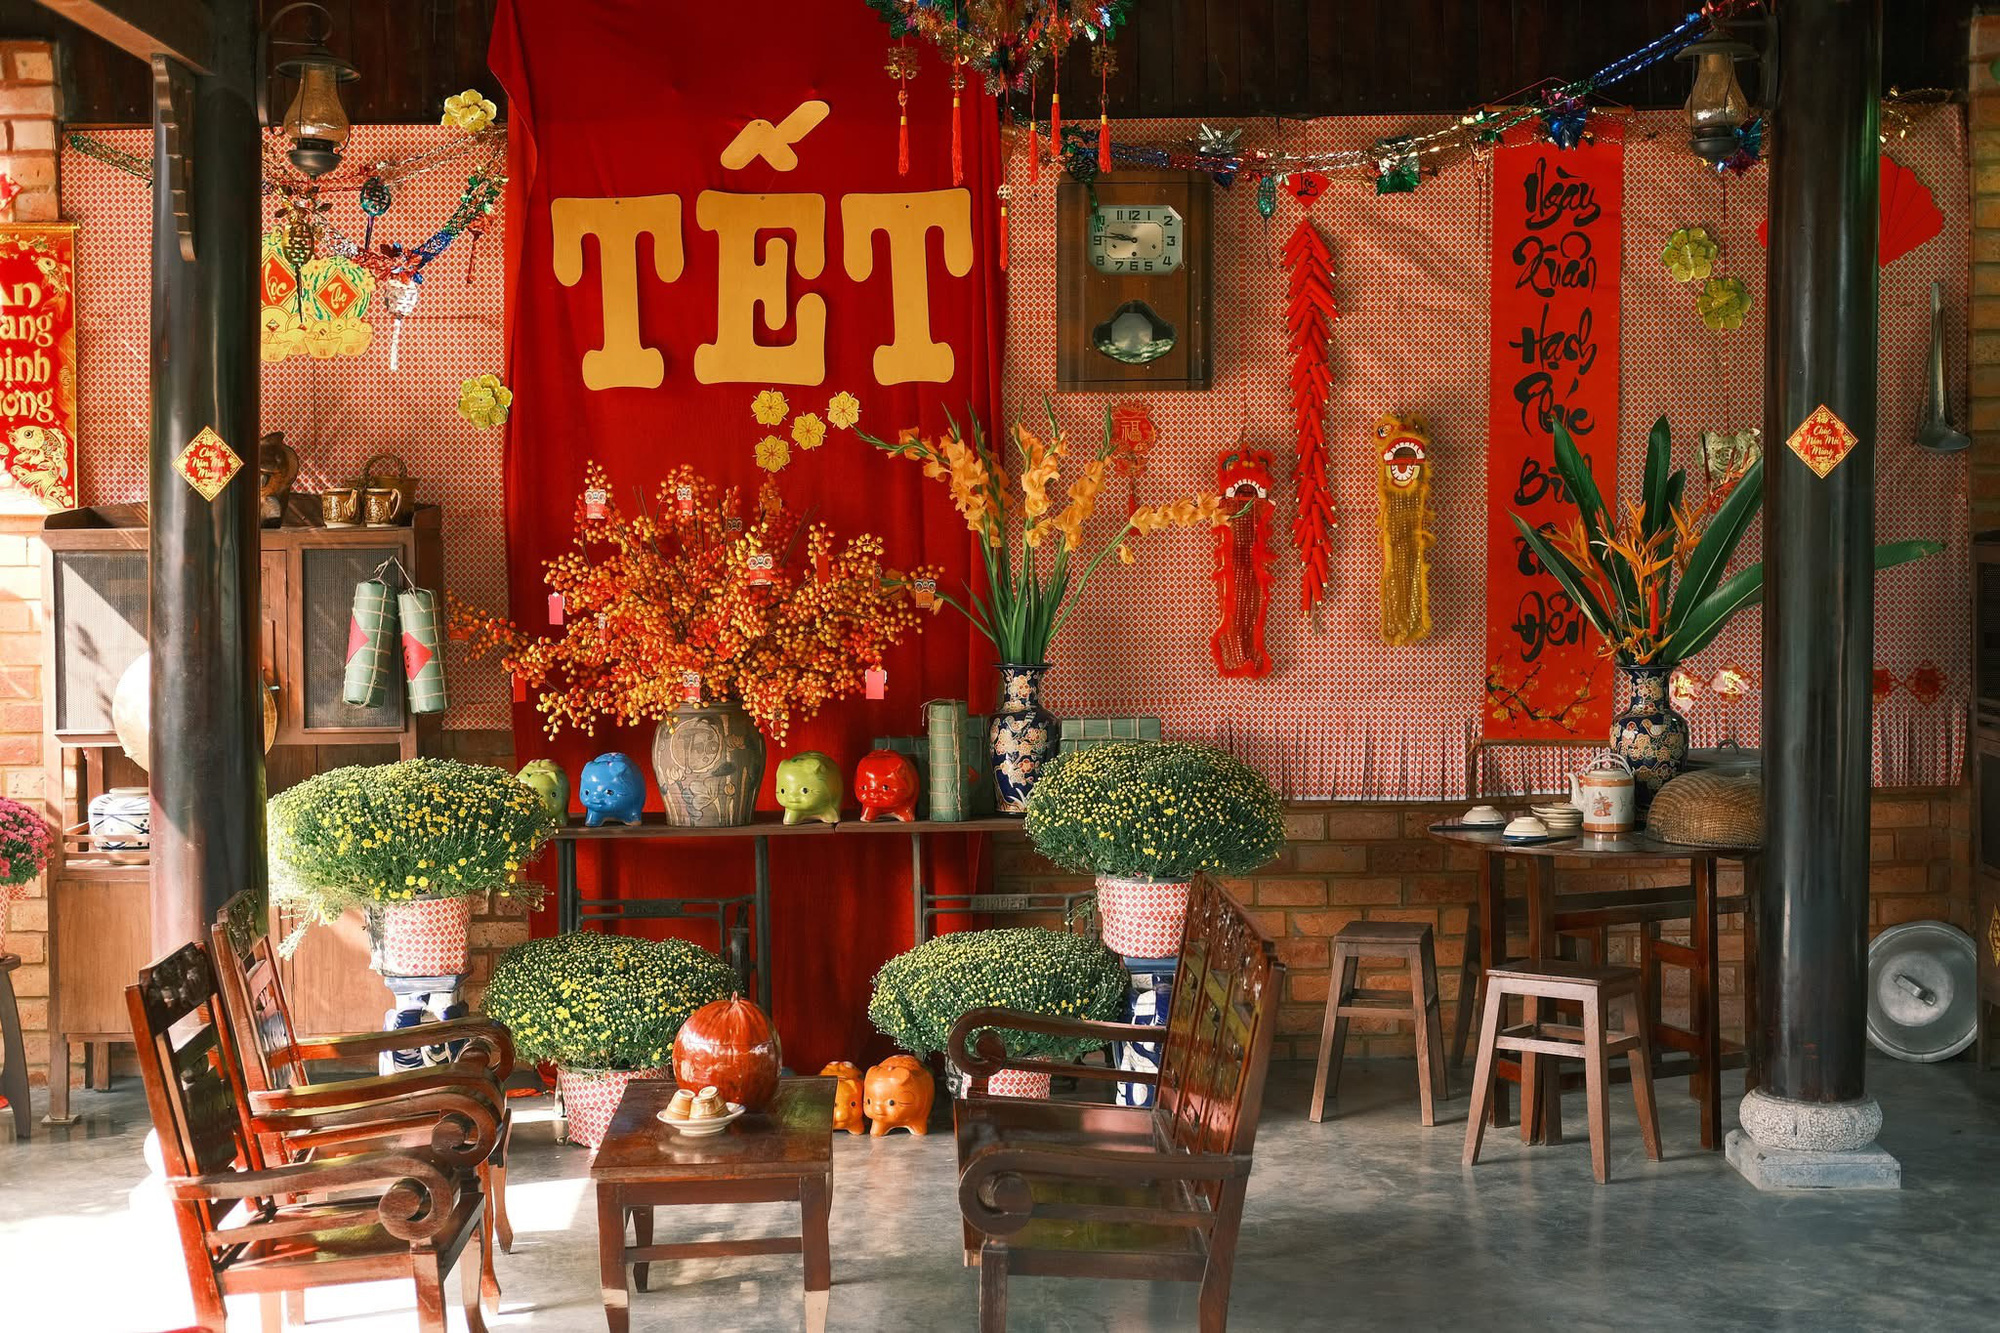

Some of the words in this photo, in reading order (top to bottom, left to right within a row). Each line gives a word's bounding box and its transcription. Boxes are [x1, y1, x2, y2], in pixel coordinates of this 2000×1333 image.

[1523, 157, 1601, 230] Ngày
[1116, 210, 1123, 221] 11
[1128, 210, 1140, 221] 12
[1147, 210, 1151, 221] 1
[1163, 215, 1173, 226] 2
[551, 100, 974, 391] TẾT
[1093, 235, 1102, 246] 9
[1166, 235, 1176, 246] 3
[1095, 255, 1105, 266] 8
[1115, 261, 1124, 271] 7
[1129, 261, 1139, 271] 6
[1144, 261, 1153, 271] 5
[1162, 255, 1173, 266] 4
[1512, 231, 1598, 298] Xuân
[0, 347, 51, 389] ịnh
[0, 388, 55, 423] ợng
